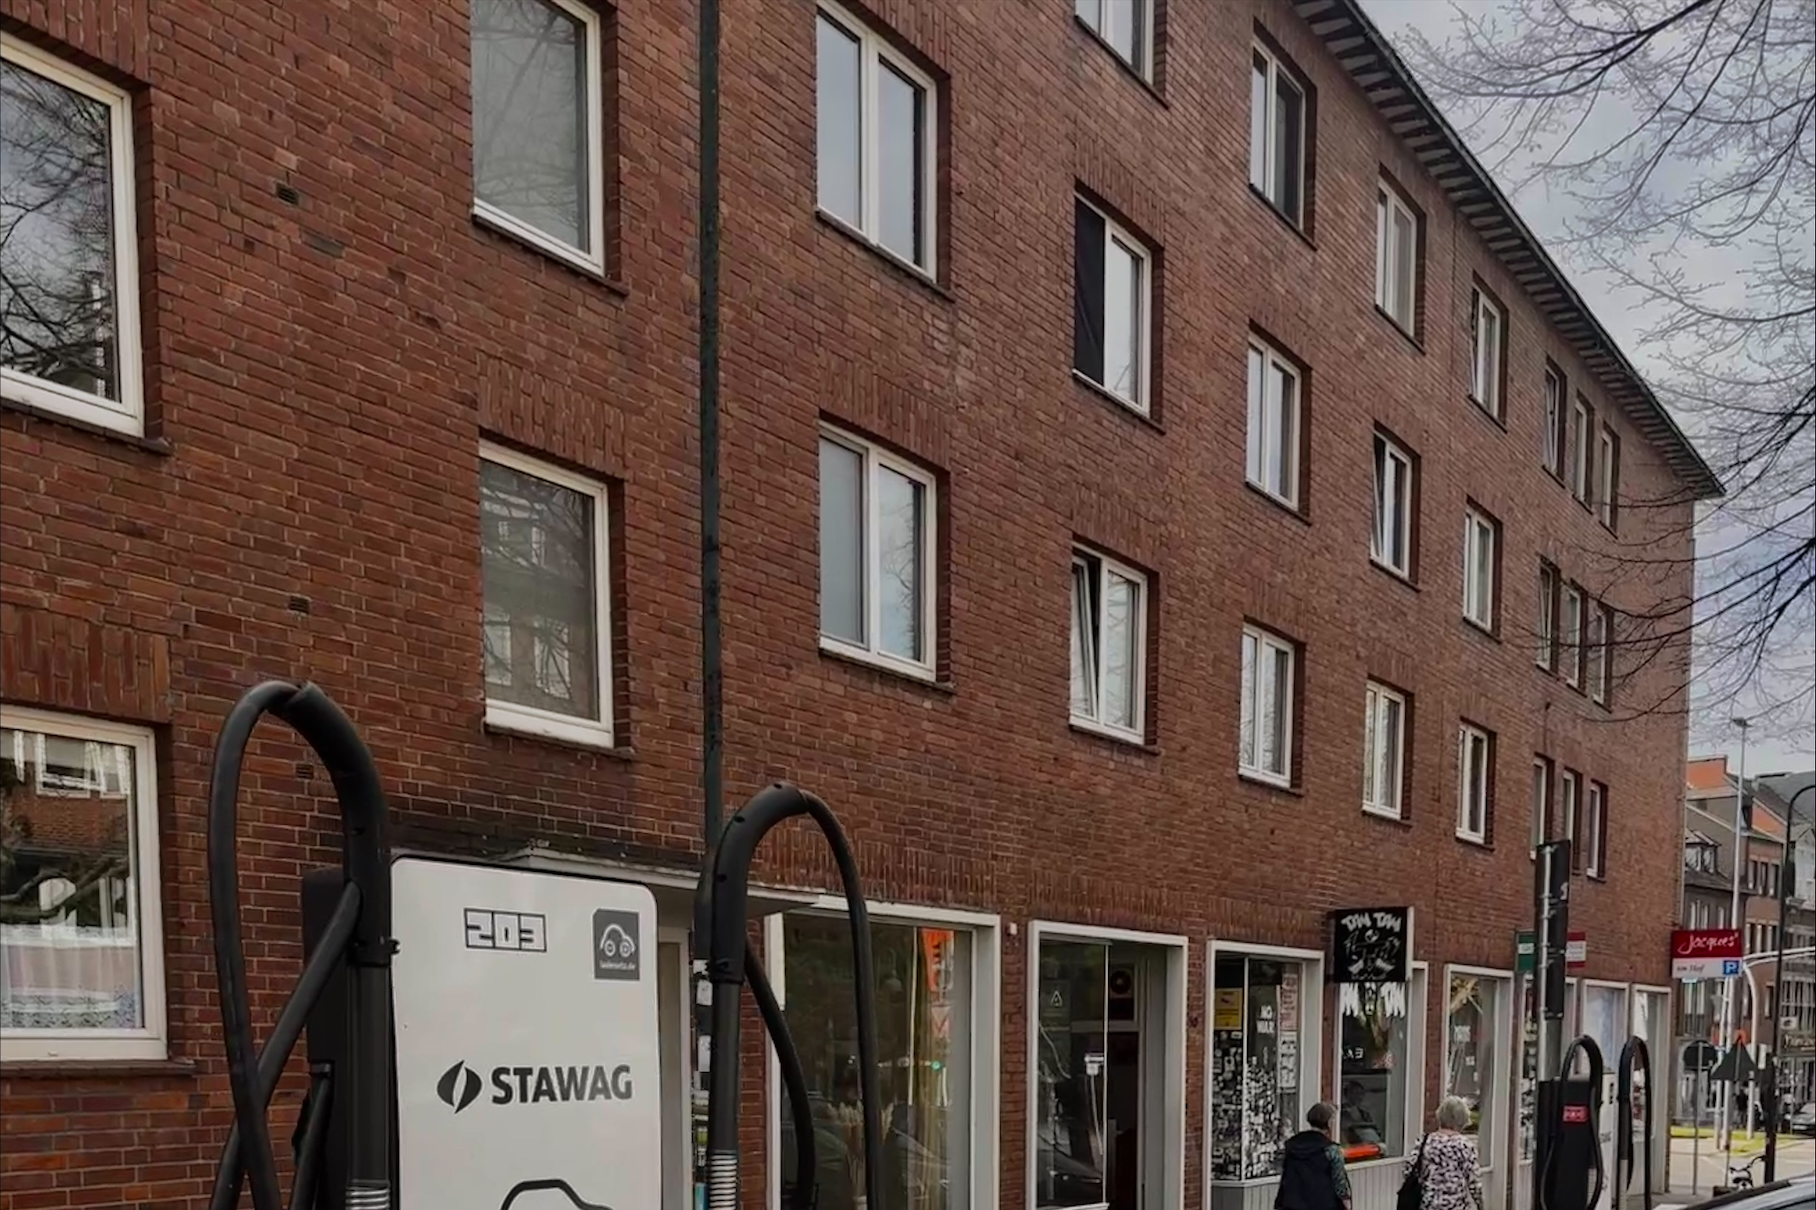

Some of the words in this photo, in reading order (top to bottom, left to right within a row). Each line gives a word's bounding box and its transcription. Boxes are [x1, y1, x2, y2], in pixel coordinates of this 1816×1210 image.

[464, 908, 547, 952] 203
[1726, 961, 1737, 975] P
[491, 1064, 633, 1104] STAWAG
